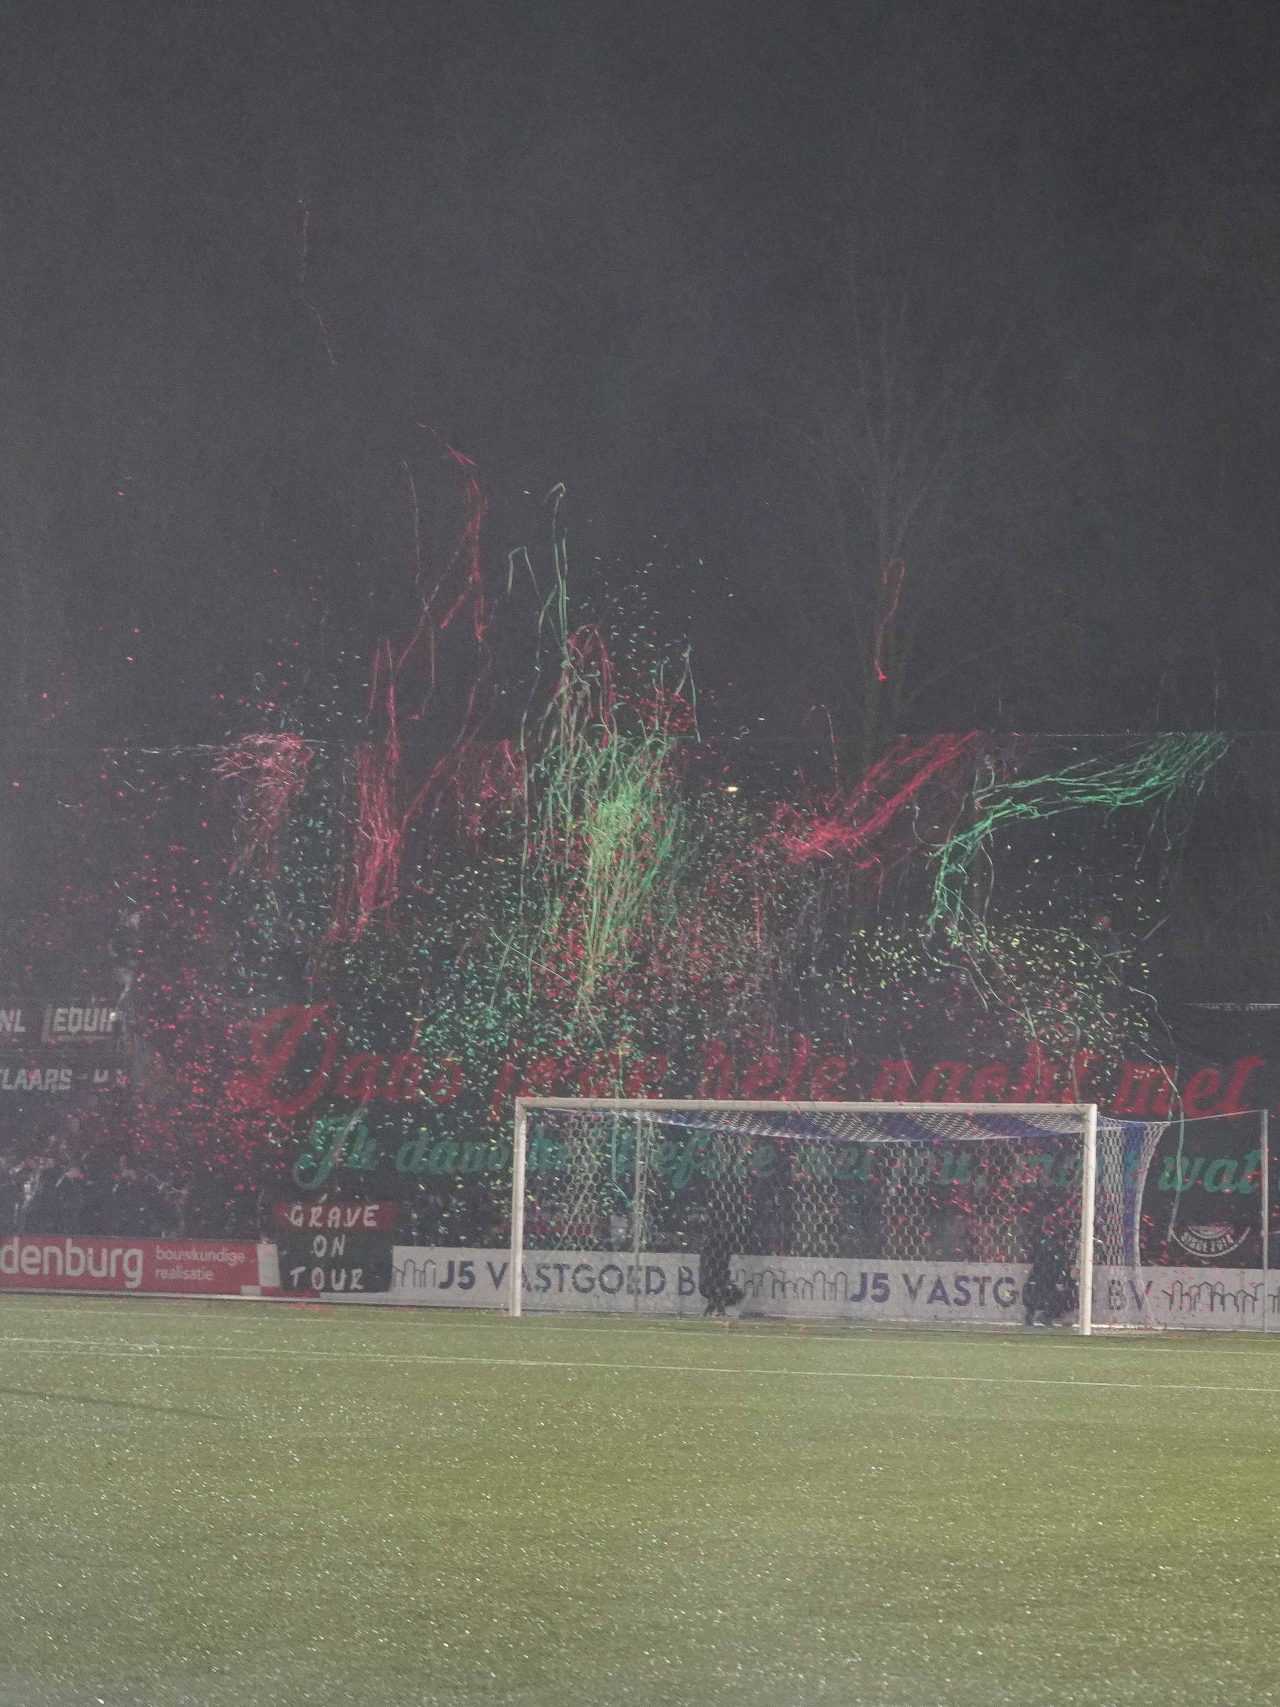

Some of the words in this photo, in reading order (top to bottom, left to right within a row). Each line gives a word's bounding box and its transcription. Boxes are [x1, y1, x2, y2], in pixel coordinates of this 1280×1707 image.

[1113, 1055, 1264, 1120] met
[1158, 1149, 1264, 1194] wat
[289, 1204, 380, 1228] GRAVE
[0, 1236, 144, 1288] denburg
[312, 1235, 345, 1258] ON
[289, 1267, 364, 1291] TOUR
[439, 1259, 476, 1289] J5
[850, 1272, 891, 1302] J5
[901, 1273, 1020, 1307] VASTG
